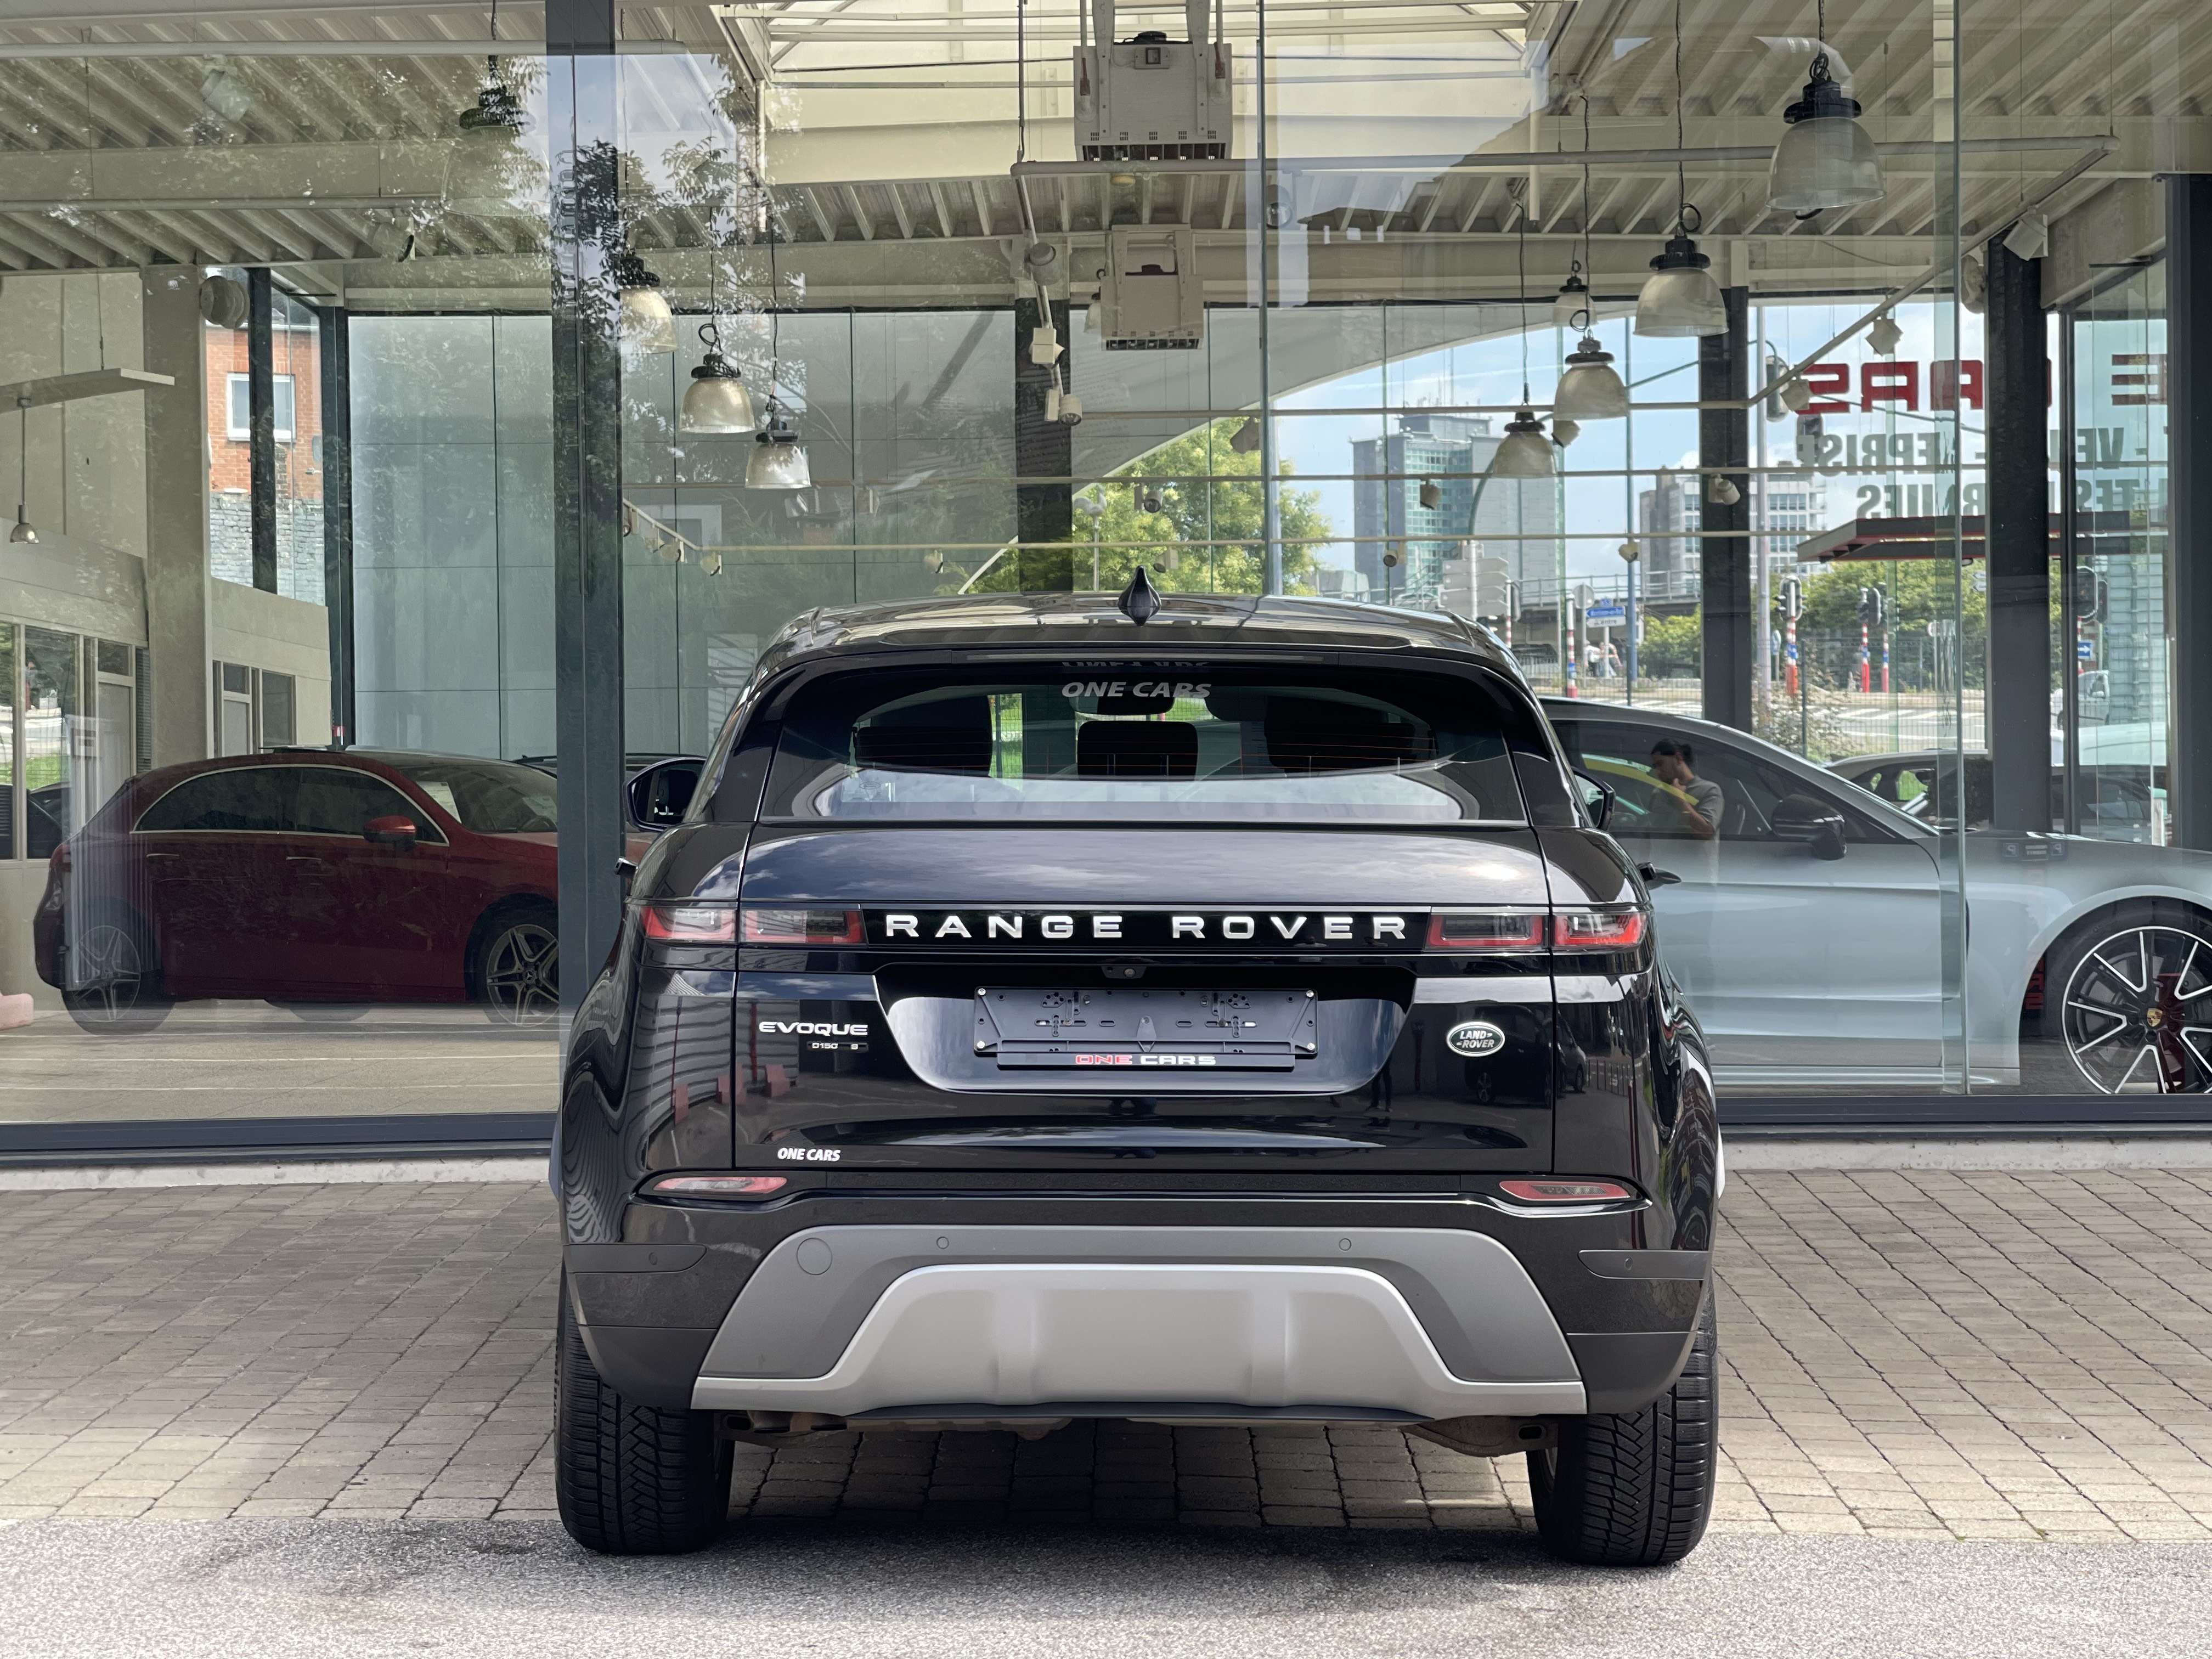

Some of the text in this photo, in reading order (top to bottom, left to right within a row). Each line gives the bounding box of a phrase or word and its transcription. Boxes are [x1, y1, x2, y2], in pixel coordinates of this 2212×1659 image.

[1062, 682, 1211, 698] ONE CARS
[886, 915, 1406, 939] RANGE ROVER
[759, 1022, 868, 1036] EVOQUE
[1459, 1030, 1487, 1039] LAND
[1462, 1039, 1494, 1048] ROVER
[1075, 1054, 1216, 1065] ONE CARS
[777, 1147, 841, 1161] ONE CARS
